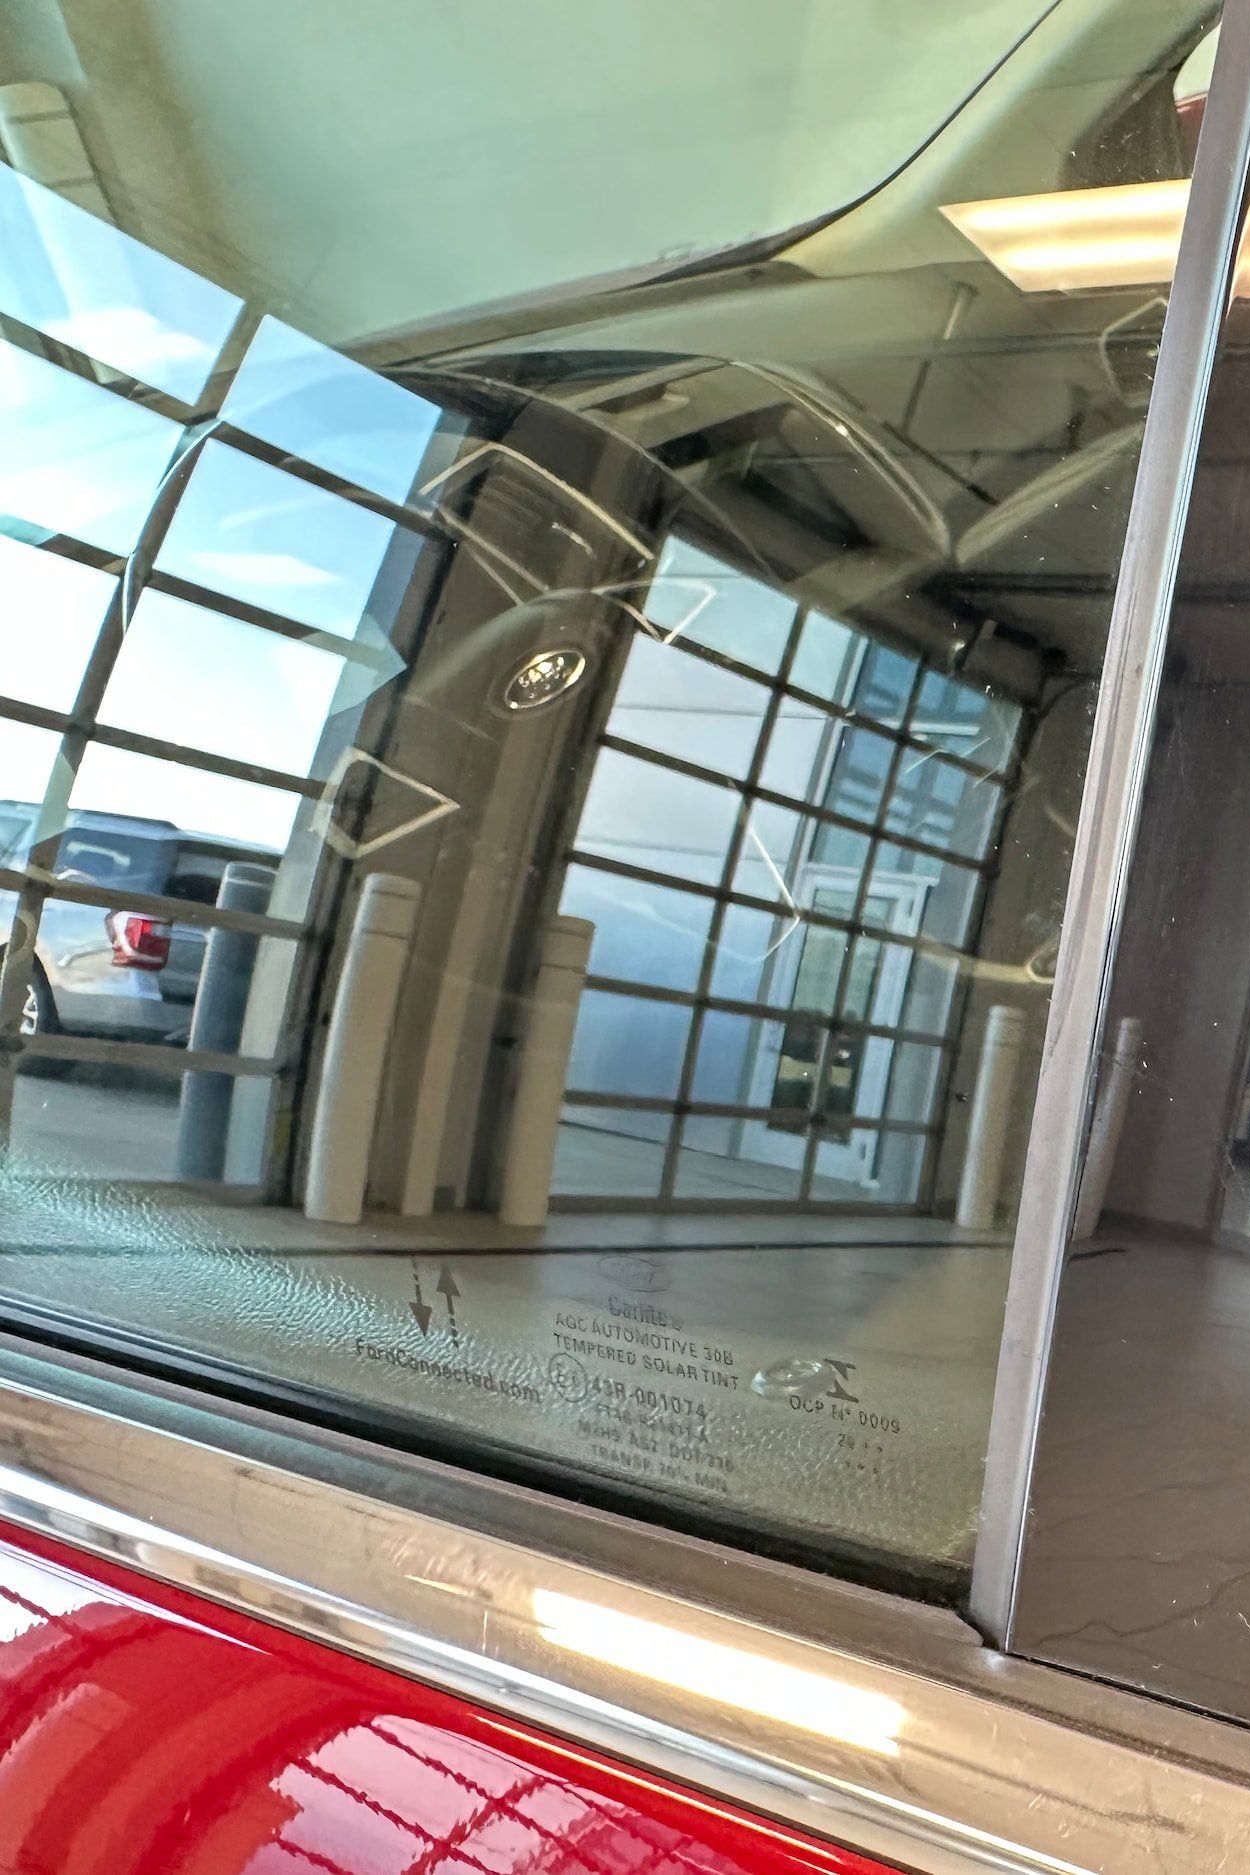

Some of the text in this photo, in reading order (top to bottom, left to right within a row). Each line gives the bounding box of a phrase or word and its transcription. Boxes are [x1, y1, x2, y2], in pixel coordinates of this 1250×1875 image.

[553, 1332, 739, 1391] TEMPERED SOLAR TINT
[592, 1318, 698, 1358] AUTOMOTIVE
